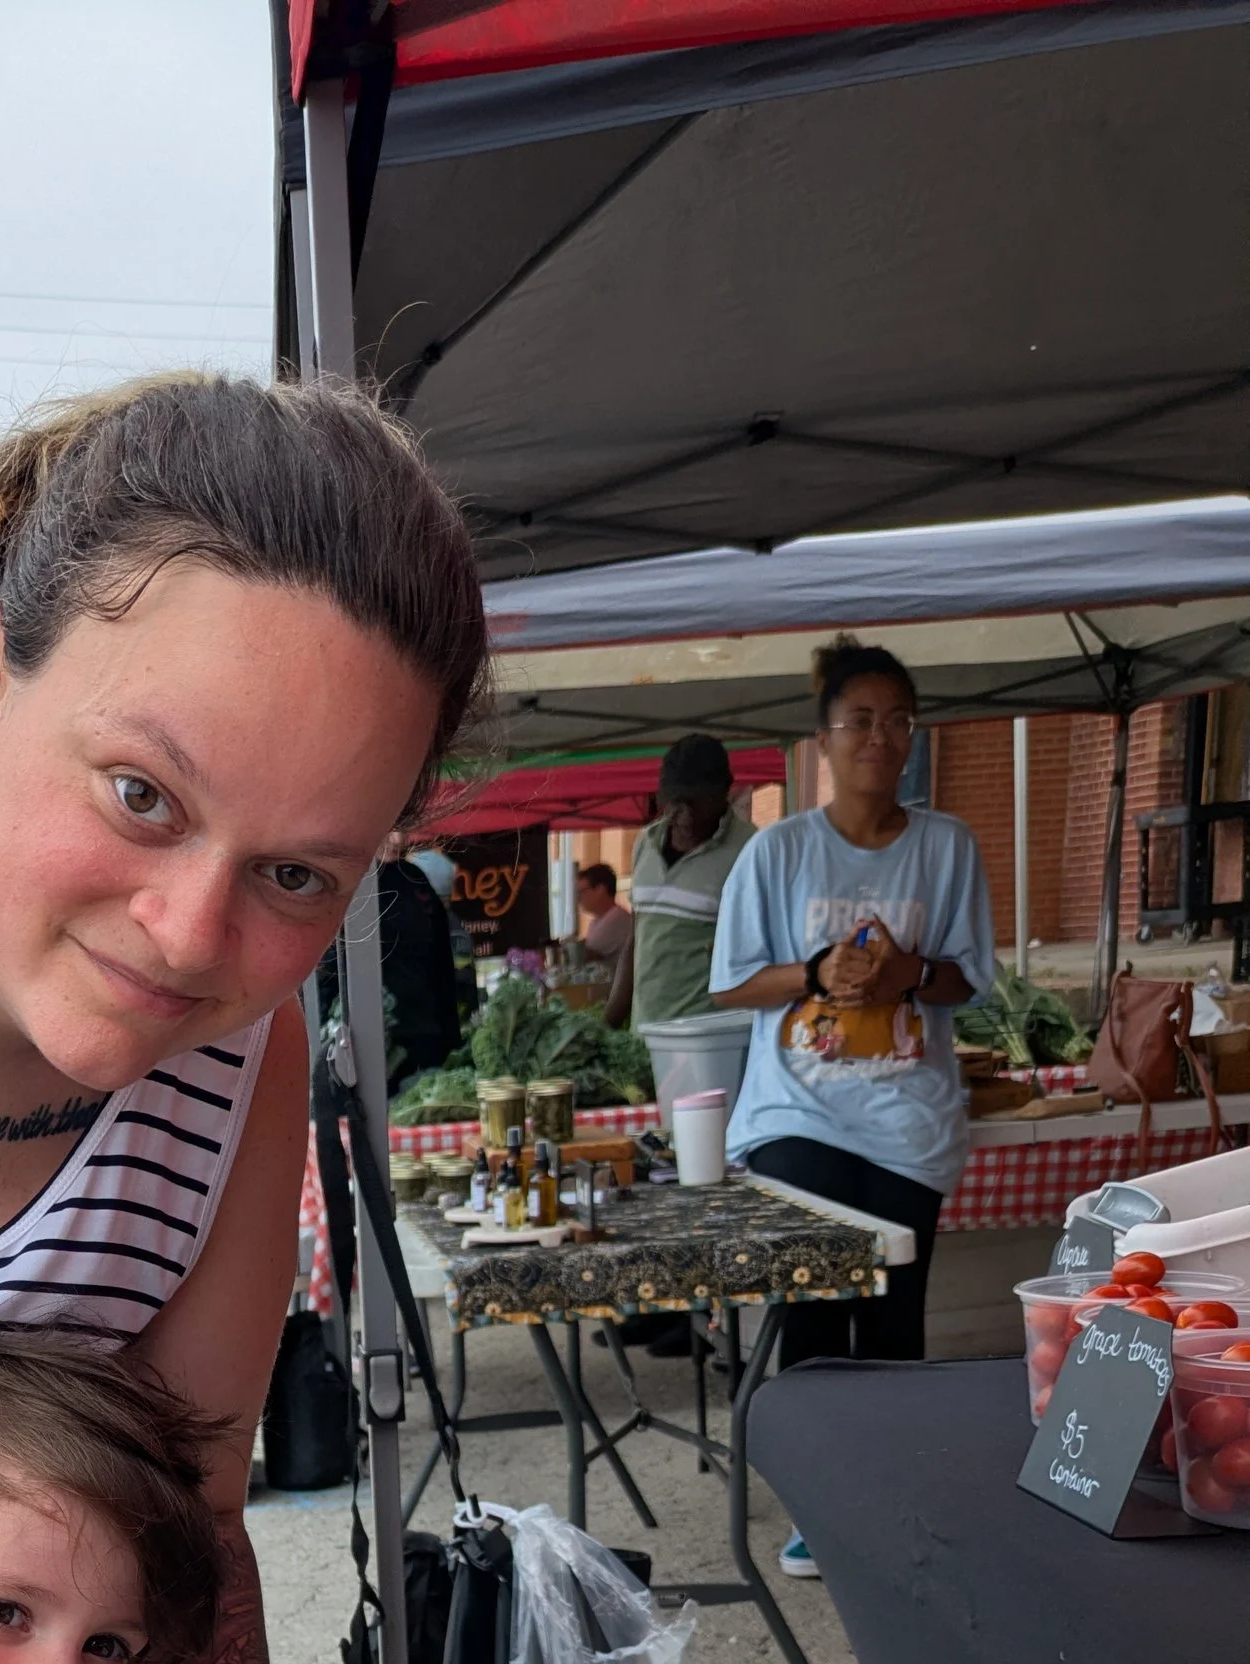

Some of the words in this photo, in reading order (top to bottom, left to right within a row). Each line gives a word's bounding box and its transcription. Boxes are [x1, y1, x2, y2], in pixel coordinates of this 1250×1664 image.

[452, 864, 529, 917] ney
[1077, 1324, 1123, 1364] grape
[1061, 1409, 1089, 1459] $5
